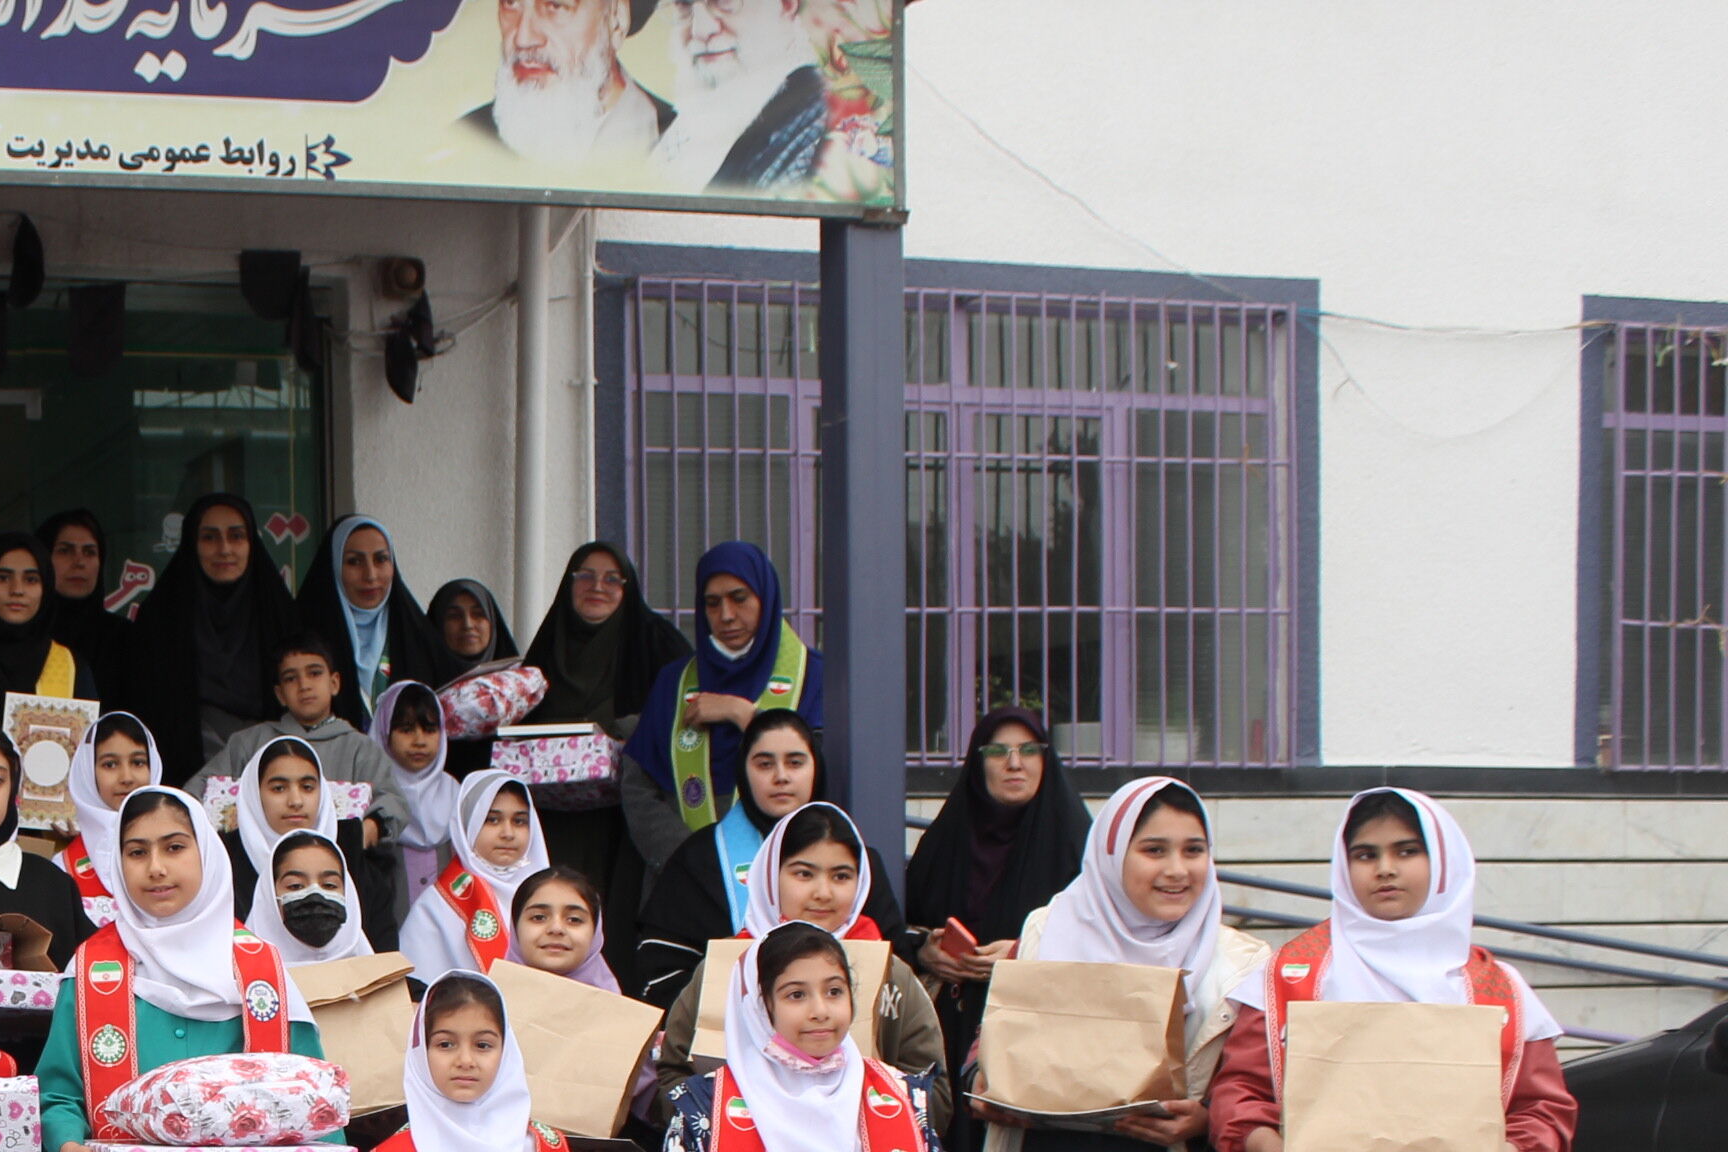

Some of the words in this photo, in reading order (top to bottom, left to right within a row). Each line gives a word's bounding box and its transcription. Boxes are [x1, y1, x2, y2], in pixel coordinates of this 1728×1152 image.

[6, 134, 111, 168] مدیریت
[118, 142, 211, 172] عمومی
[218, 136, 297, 177] روابط
